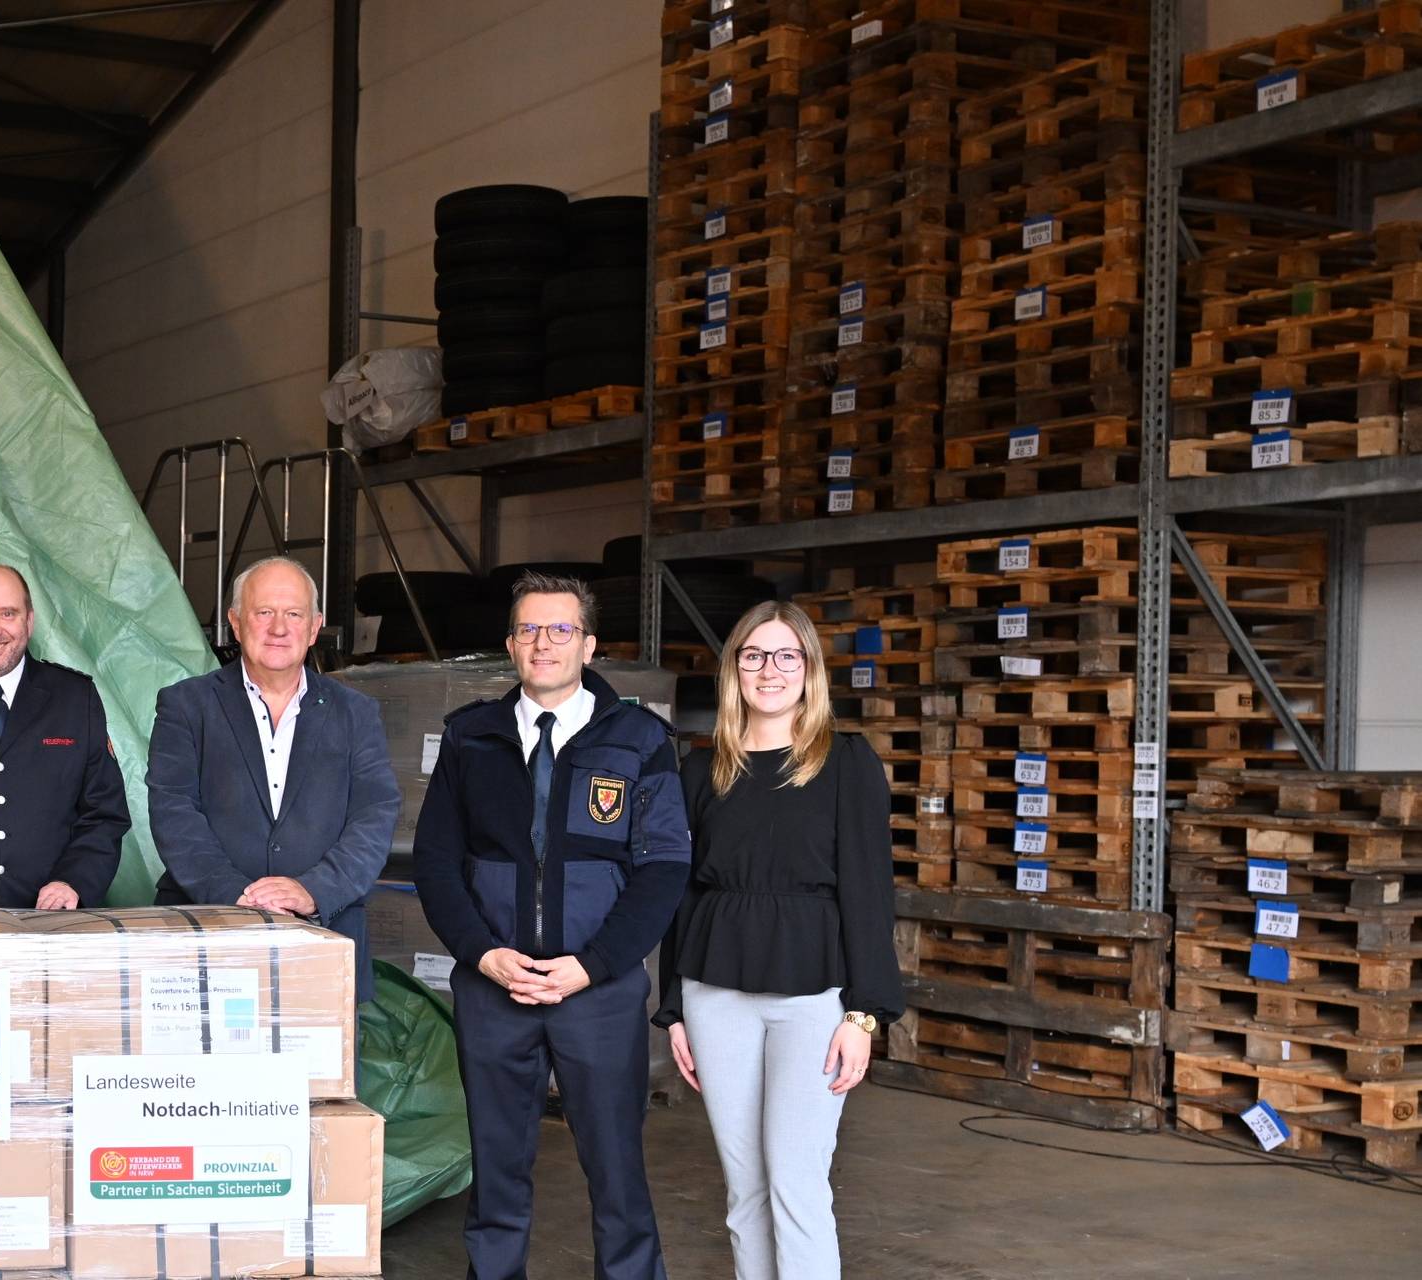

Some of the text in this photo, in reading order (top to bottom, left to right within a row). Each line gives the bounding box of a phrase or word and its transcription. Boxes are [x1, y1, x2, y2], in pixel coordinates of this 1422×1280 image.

[1258, 409, 1281, 421] 85.3
[1259, 453, 1282, 464] 72.3
[1003, 556, 1027, 567] 154.3
[1002, 625, 1025, 635] 157.2
[1020, 771, 1039, 781] 63.2
[593, 779, 623, 789] FEUERWEHR
[1023, 804, 1042, 814] 69.3
[1022, 841, 1039, 851] 72.1
[1022, 879, 1041, 889] 47.3
[1257, 879, 1280, 890] 46.2
[1265, 923, 1290, 935] 47.2
[151, 1002, 170, 1012] 15m
[180, 1002, 200, 1012] 15m
[85, 1074, 196, 1090] Landesweite
[142, 1101, 300, 1118] Notdach-Initiative
[1250, 1119, 1273, 1143] 25.3
[129, 1156, 165, 1164] VERBAND
[129, 1163, 183, 1171] FEUERWEHREN
[203, 1162, 278, 1174] PROVINZIAL
[100, 1181, 282, 1197] Partner in Sachen Sicherheit
